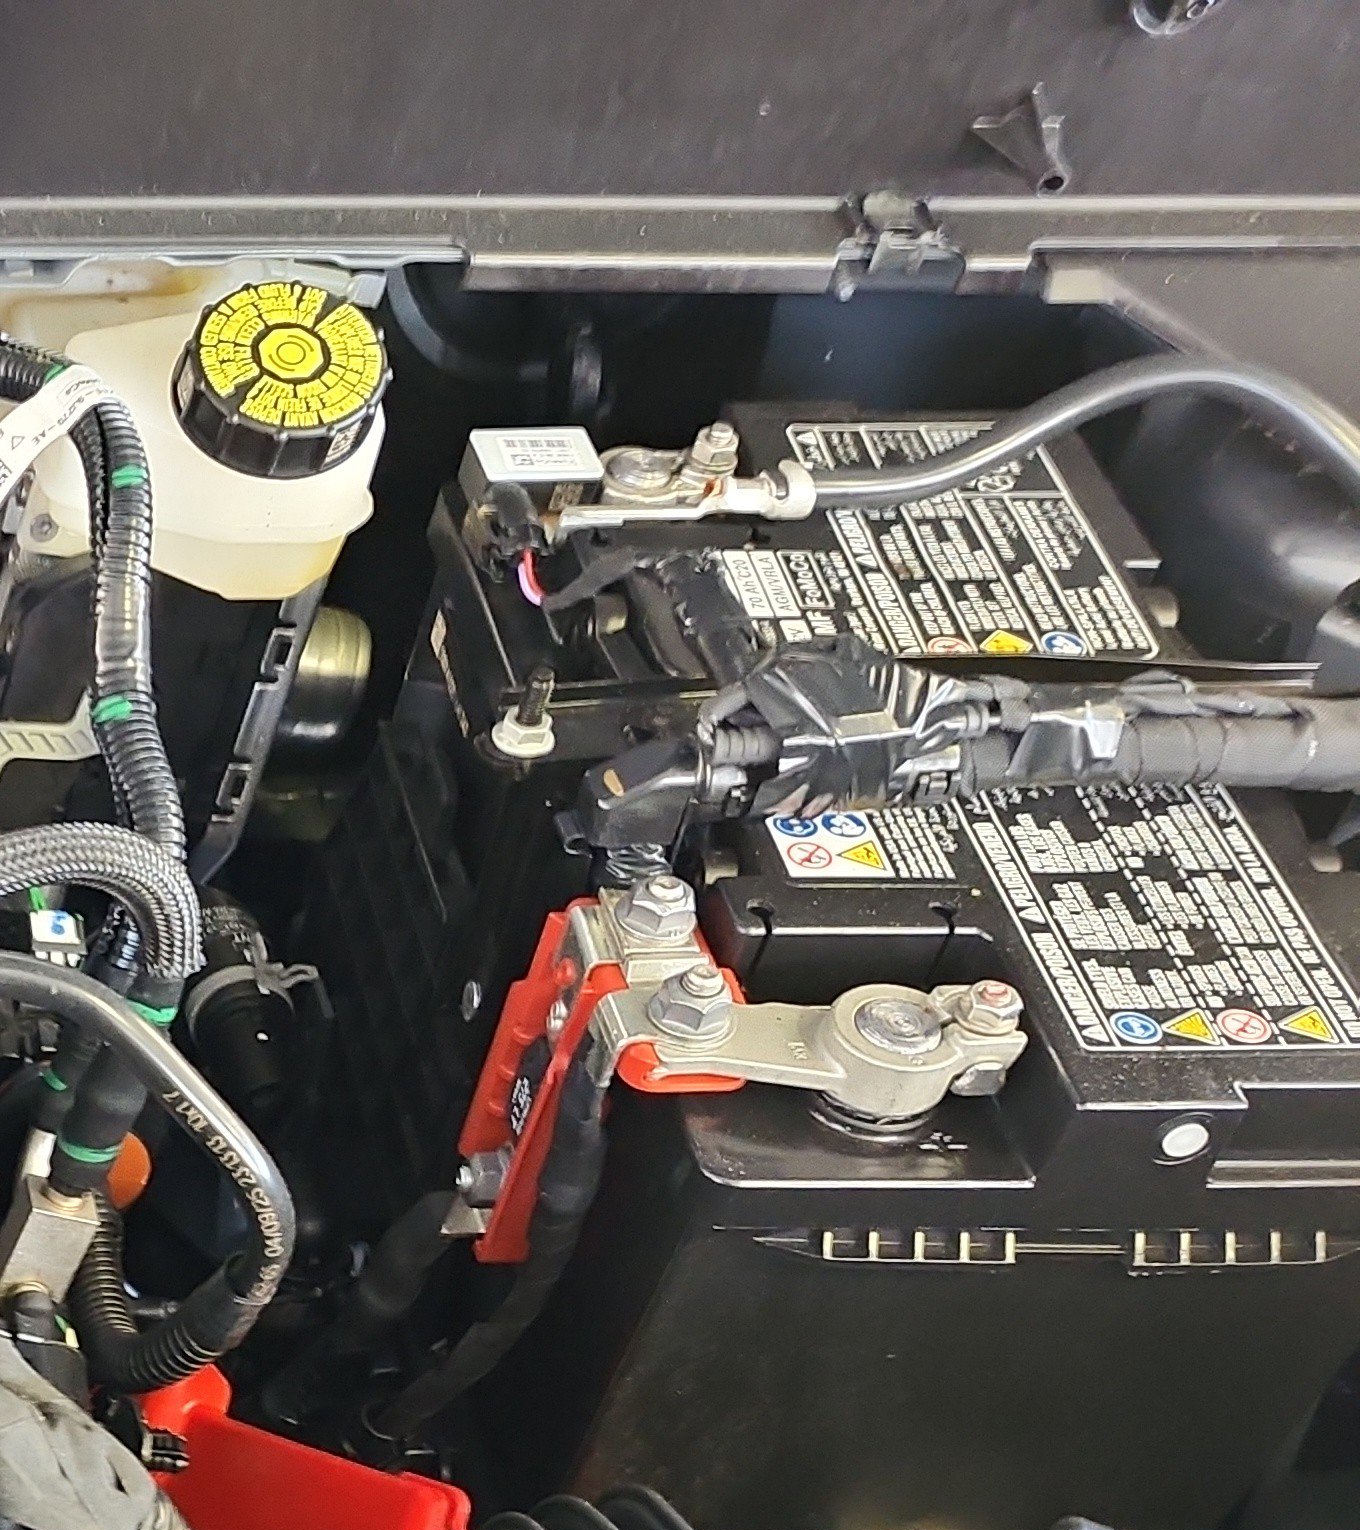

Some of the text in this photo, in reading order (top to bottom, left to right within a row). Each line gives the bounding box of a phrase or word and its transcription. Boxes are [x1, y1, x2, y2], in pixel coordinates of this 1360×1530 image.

[731, 559, 765, 608] 70 Ah C20
[756, 556, 793, 611] AGM/VRLA
[783, 554, 829, 606] FoMoCo
[804, 609, 840, 634] MF
[862, 572, 920, 646] DANGER/POISON
[969, 821, 1037, 906] PELIGRO/VENENO
[1029, 932, 1101, 1024] DANGER/POISON
